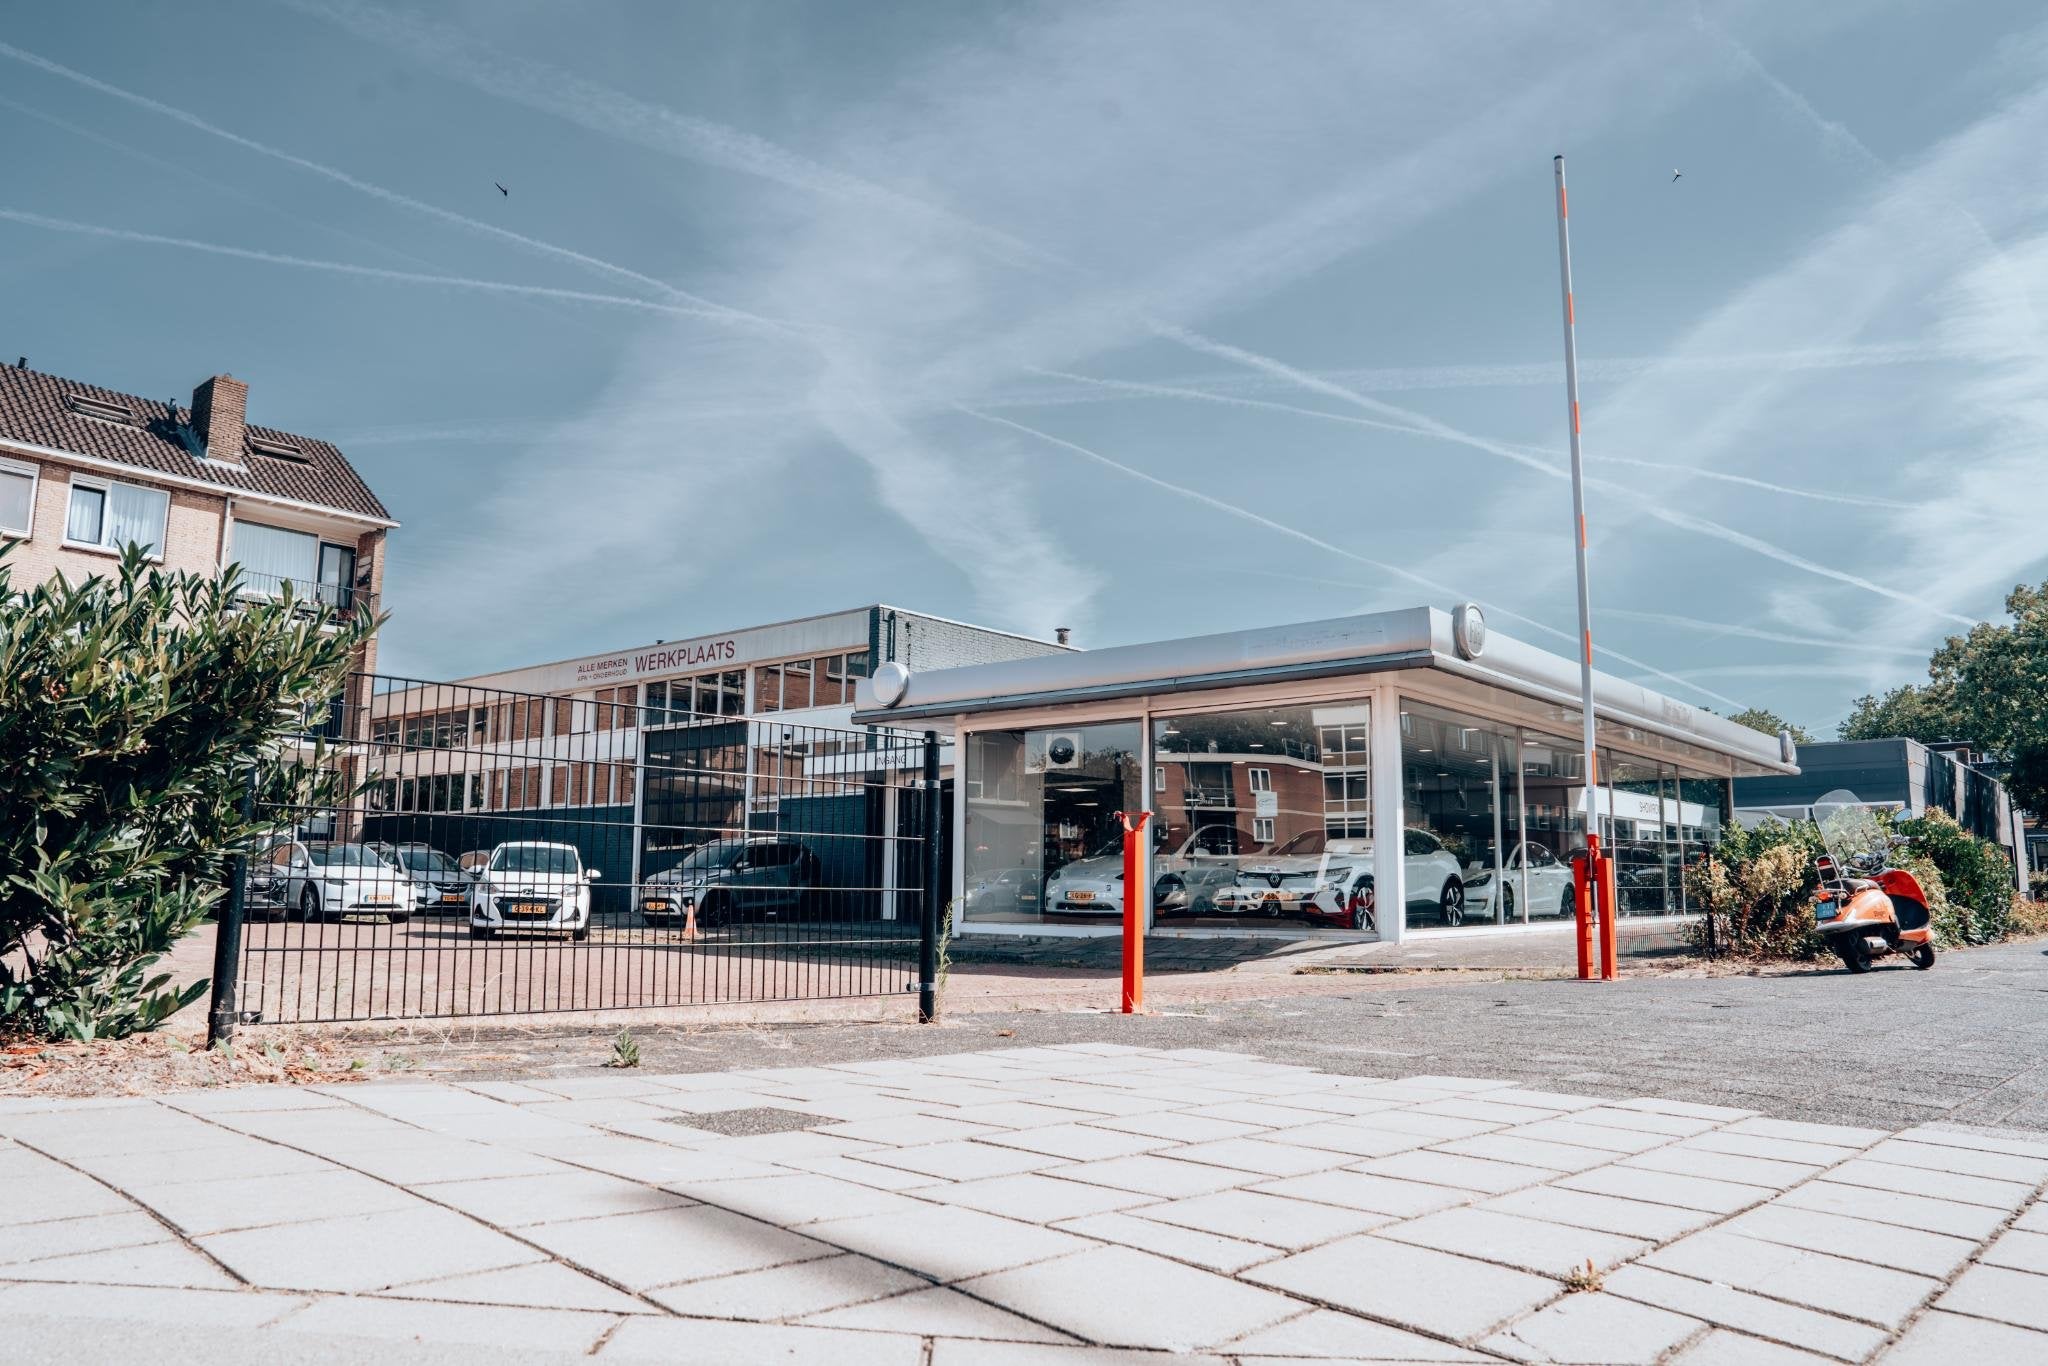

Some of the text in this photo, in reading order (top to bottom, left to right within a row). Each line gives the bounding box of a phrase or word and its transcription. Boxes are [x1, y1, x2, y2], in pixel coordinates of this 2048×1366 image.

[635, 640, 735, 672] WERKPLAATS
[577, 658, 628, 673] ALLE MERKEN
[875, 755, 906, 766] INGANG
[1639, 801, 1659, 814] SHOWRO
